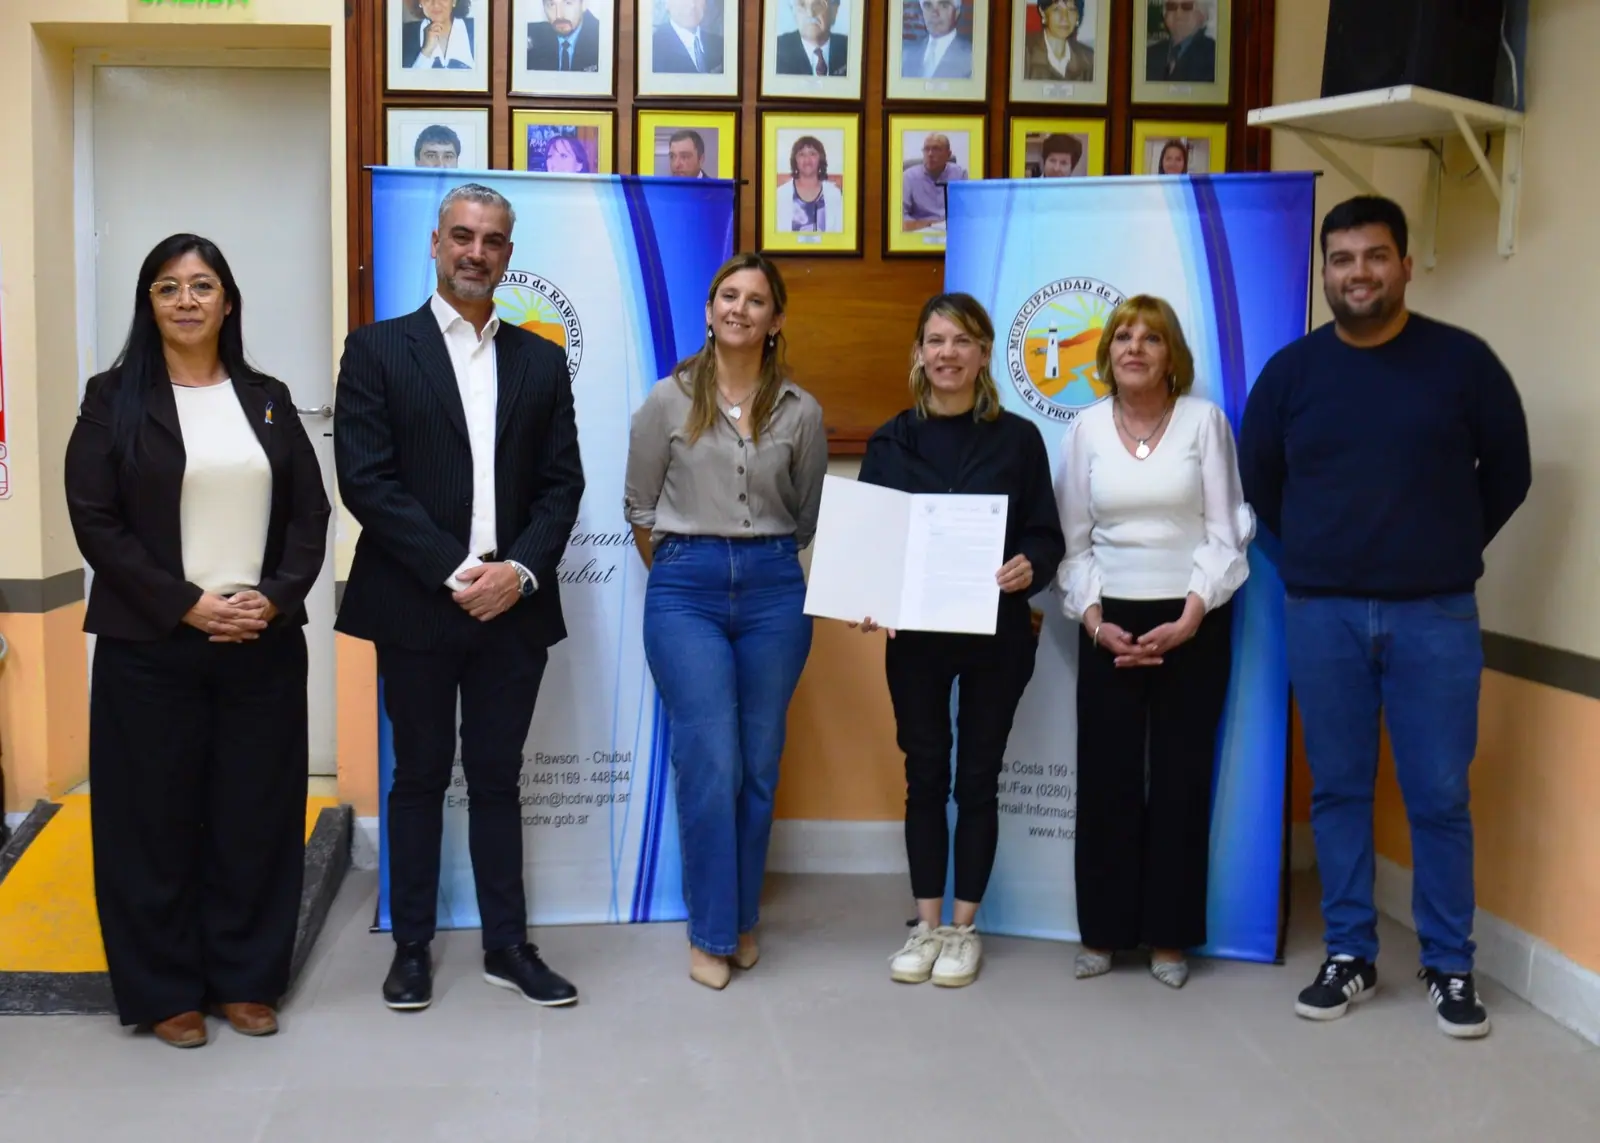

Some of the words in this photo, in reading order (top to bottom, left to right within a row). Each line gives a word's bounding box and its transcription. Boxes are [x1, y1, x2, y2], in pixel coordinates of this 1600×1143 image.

[501, 273, 528, 284] DAD
[532, 279, 547, 292] de
[549, 290, 581, 349] RAWSON
[1009, 279, 1092, 351] MUNICIPALIDAD
[1096, 285, 1111, 298] de
[1023, 388, 1033, 402] de
[1035, 398, 1045, 412] la
[1047, 407, 1079, 421] PROV
[556, 558, 617, 584] ubut
[535, 752, 580, 765] Rawson
[592, 751, 631, 764] Chubut
[532, 771, 580, 785] 4481169
[590, 770, 630, 783] 448544
[1012, 760, 1044, 775] Costa
[1048, 764, 1068, 777] 199
[447, 795, 469, 808] E-m
[520, 792, 630, 808] ación@hcdrw.gov.ar
[1036, 783, 1071, 802] (0280)
